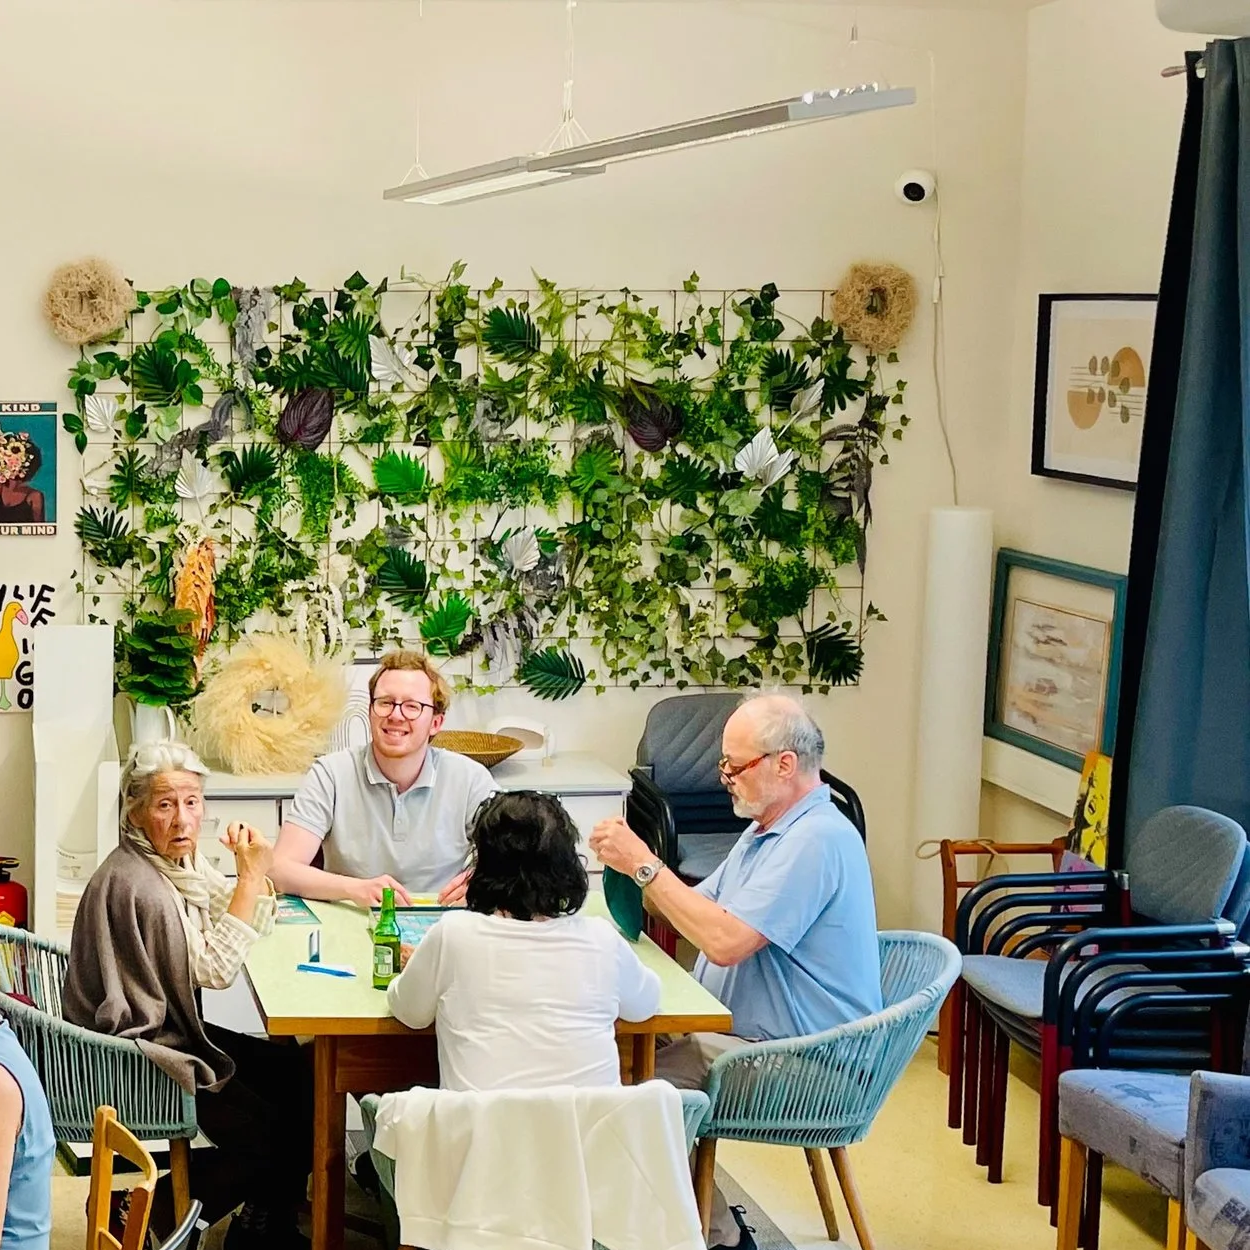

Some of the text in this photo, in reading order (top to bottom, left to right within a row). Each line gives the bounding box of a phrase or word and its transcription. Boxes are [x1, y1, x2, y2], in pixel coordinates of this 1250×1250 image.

[1, 403, 41, 412] KIND
[22, 525, 55, 535] MIND
[22, 638, 35, 654] I
